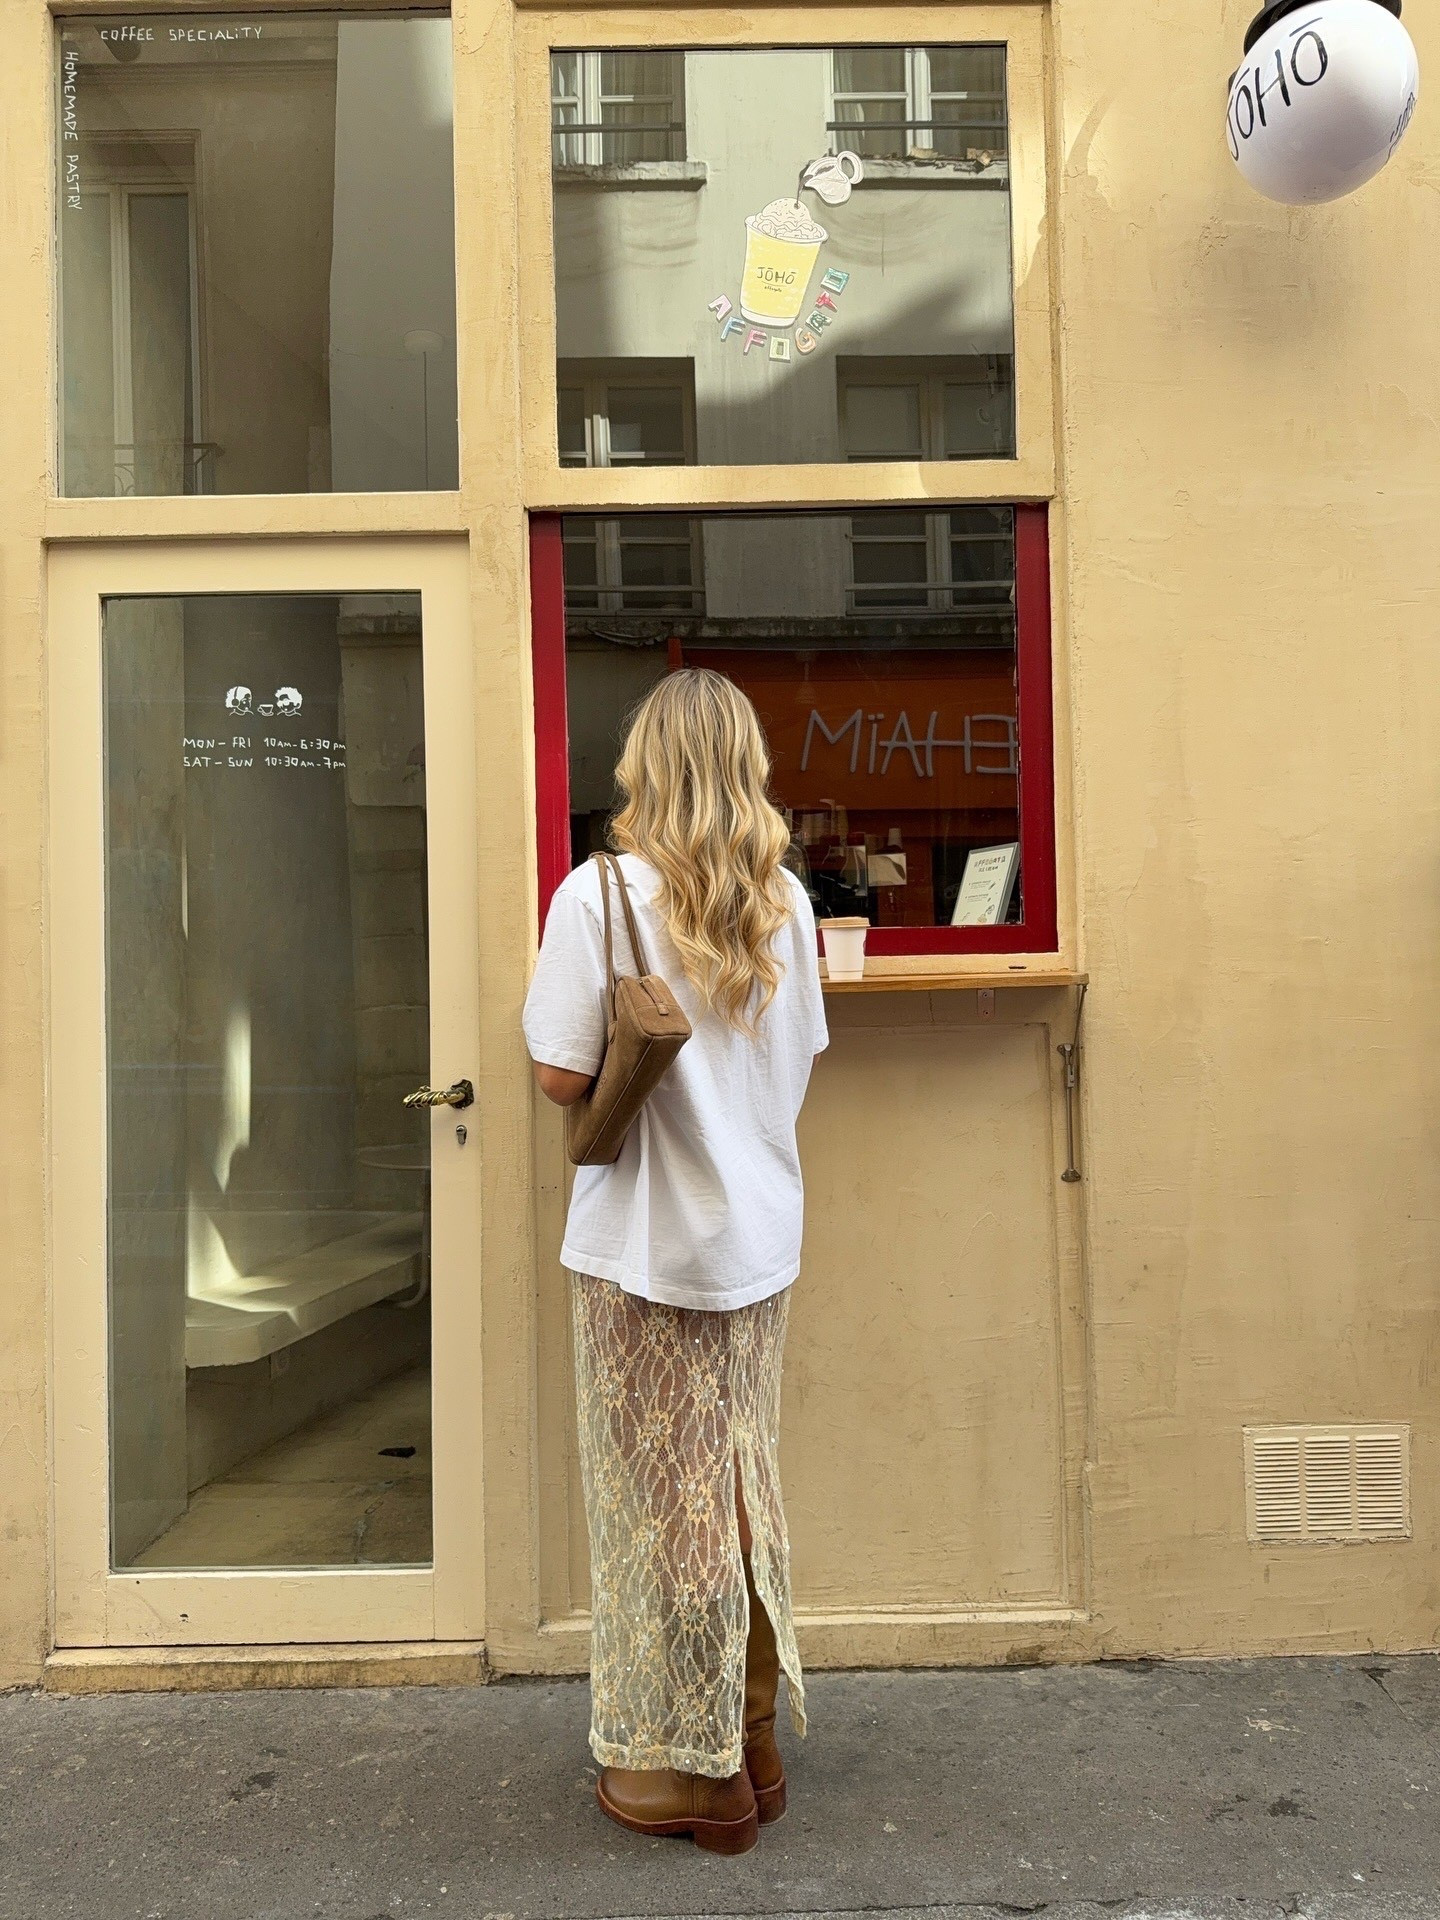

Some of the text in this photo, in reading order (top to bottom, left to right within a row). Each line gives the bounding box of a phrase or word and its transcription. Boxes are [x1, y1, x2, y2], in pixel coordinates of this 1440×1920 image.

[100, 26, 154, 41] COFFEE
[64, 51, 83, 210] HOMEMADE PASTRY
[708, 267, 850, 363] AFFOGATO
